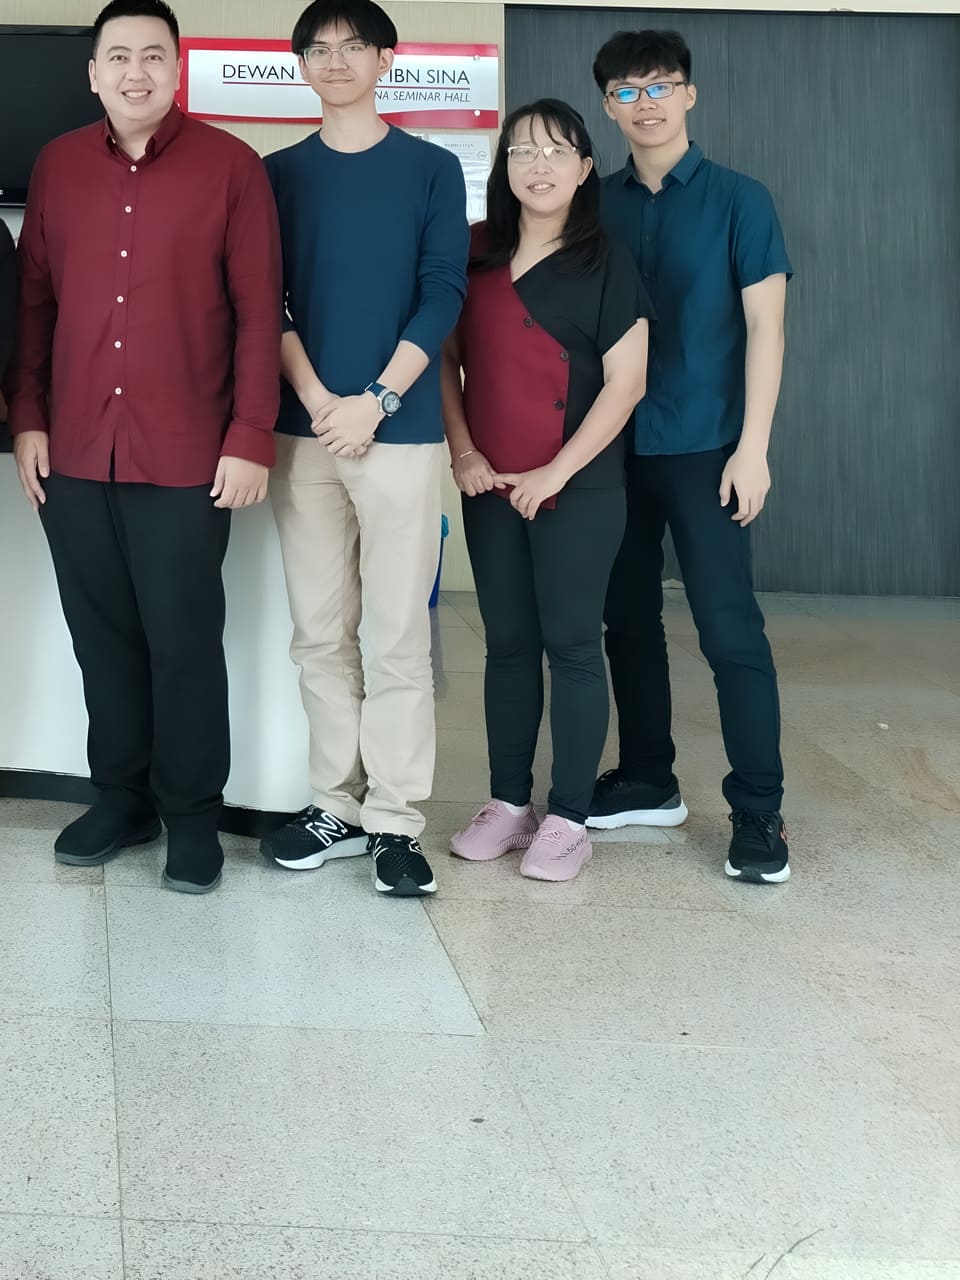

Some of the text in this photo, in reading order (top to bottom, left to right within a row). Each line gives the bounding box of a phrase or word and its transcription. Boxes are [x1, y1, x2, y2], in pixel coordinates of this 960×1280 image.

[222, 63, 470, 85] DEWAN IBN SINA
[393, 90, 441, 102] SEMINAR
[444, 92, 470, 103] HALL
